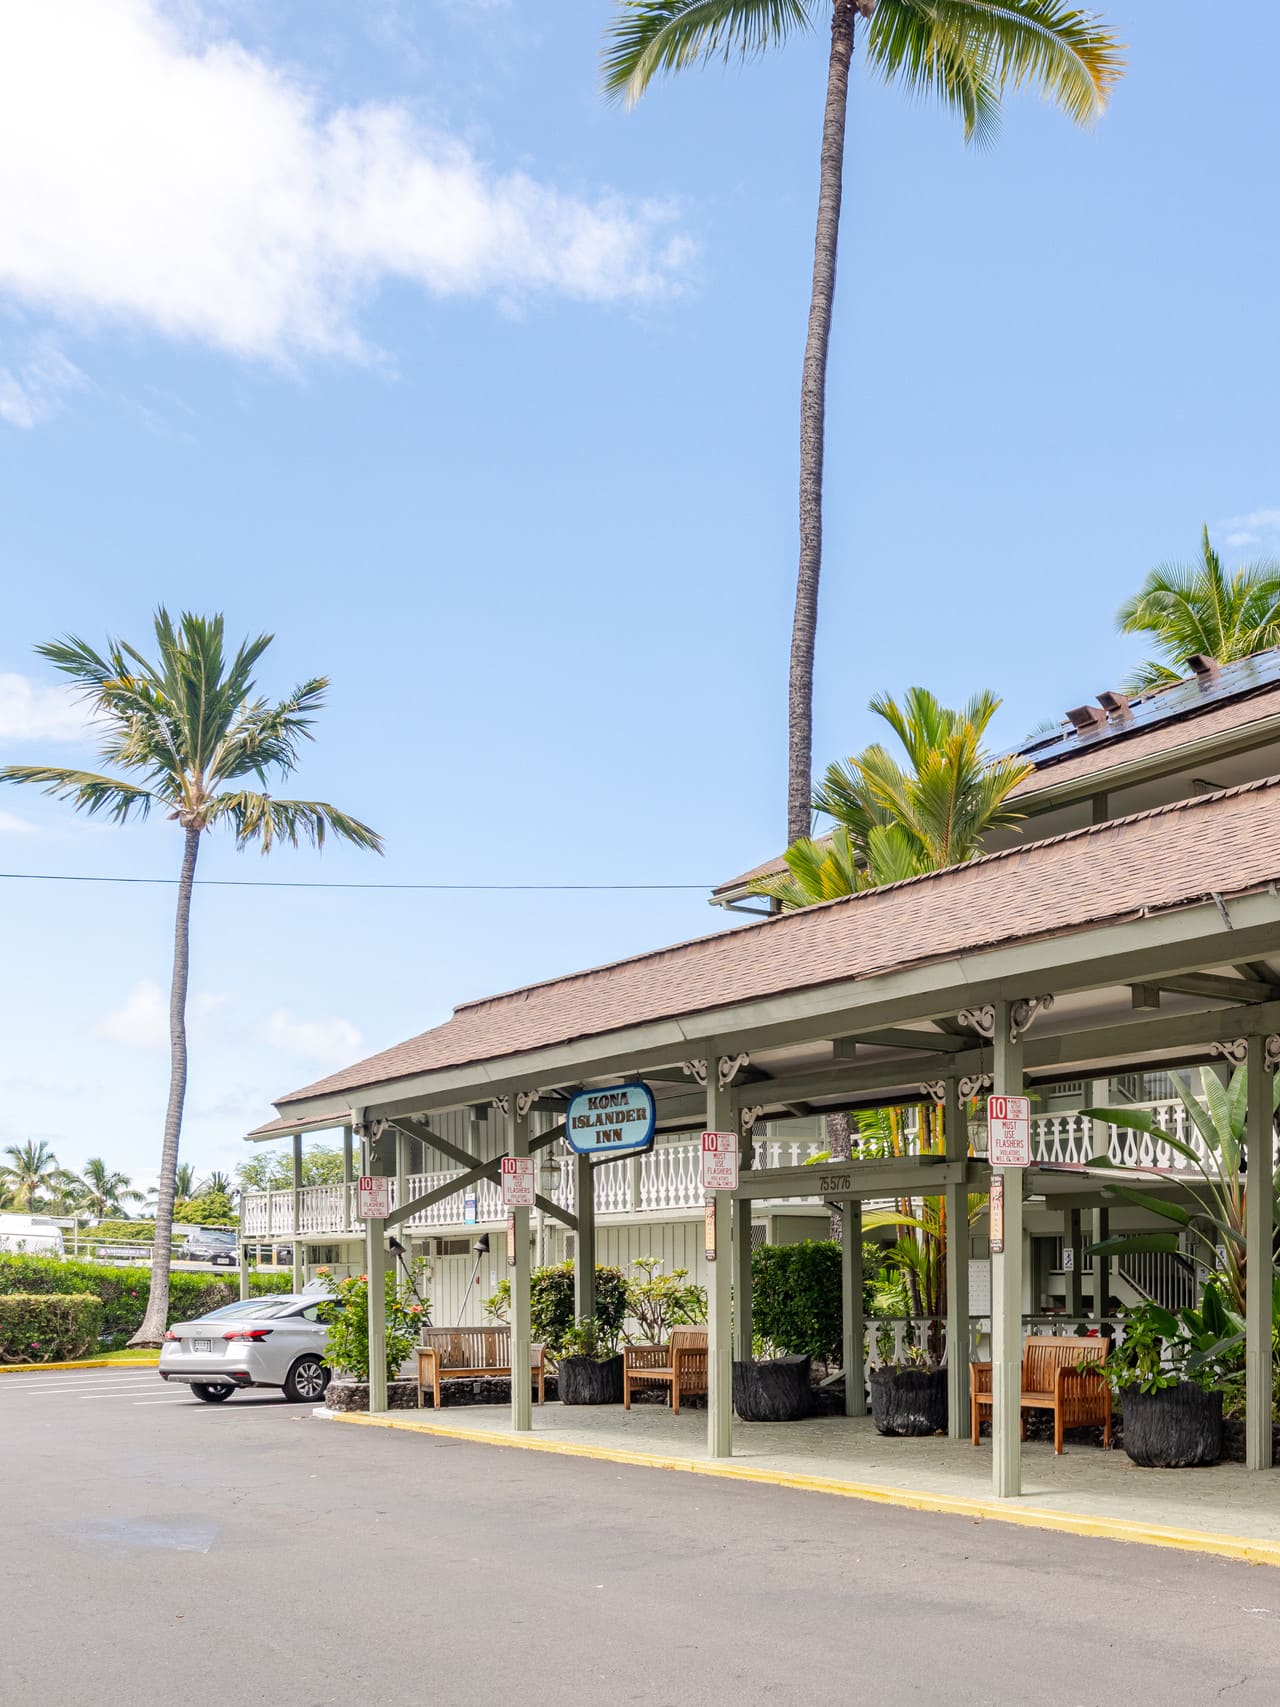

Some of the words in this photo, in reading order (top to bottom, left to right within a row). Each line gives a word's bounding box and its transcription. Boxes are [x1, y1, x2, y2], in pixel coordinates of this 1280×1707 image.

[588, 1092, 629, 1110] KONA
[992, 1098, 1006, 1118] 10
[572, 1107, 647, 1129] ISLANDER
[1002, 1121, 1017, 1130] MUST
[595, 1128, 623, 1144] INN
[704, 1134, 716, 1150] 10
[996, 1139, 1024, 1148] FLASHERS
[713, 1152, 725, 1160] MUST
[504, 1159, 516, 1173] 10
[715, 1160, 724, 1168] USE
[708, 1167, 732, 1175] FLASHERS
[361, 1178, 372, 1190] 10
